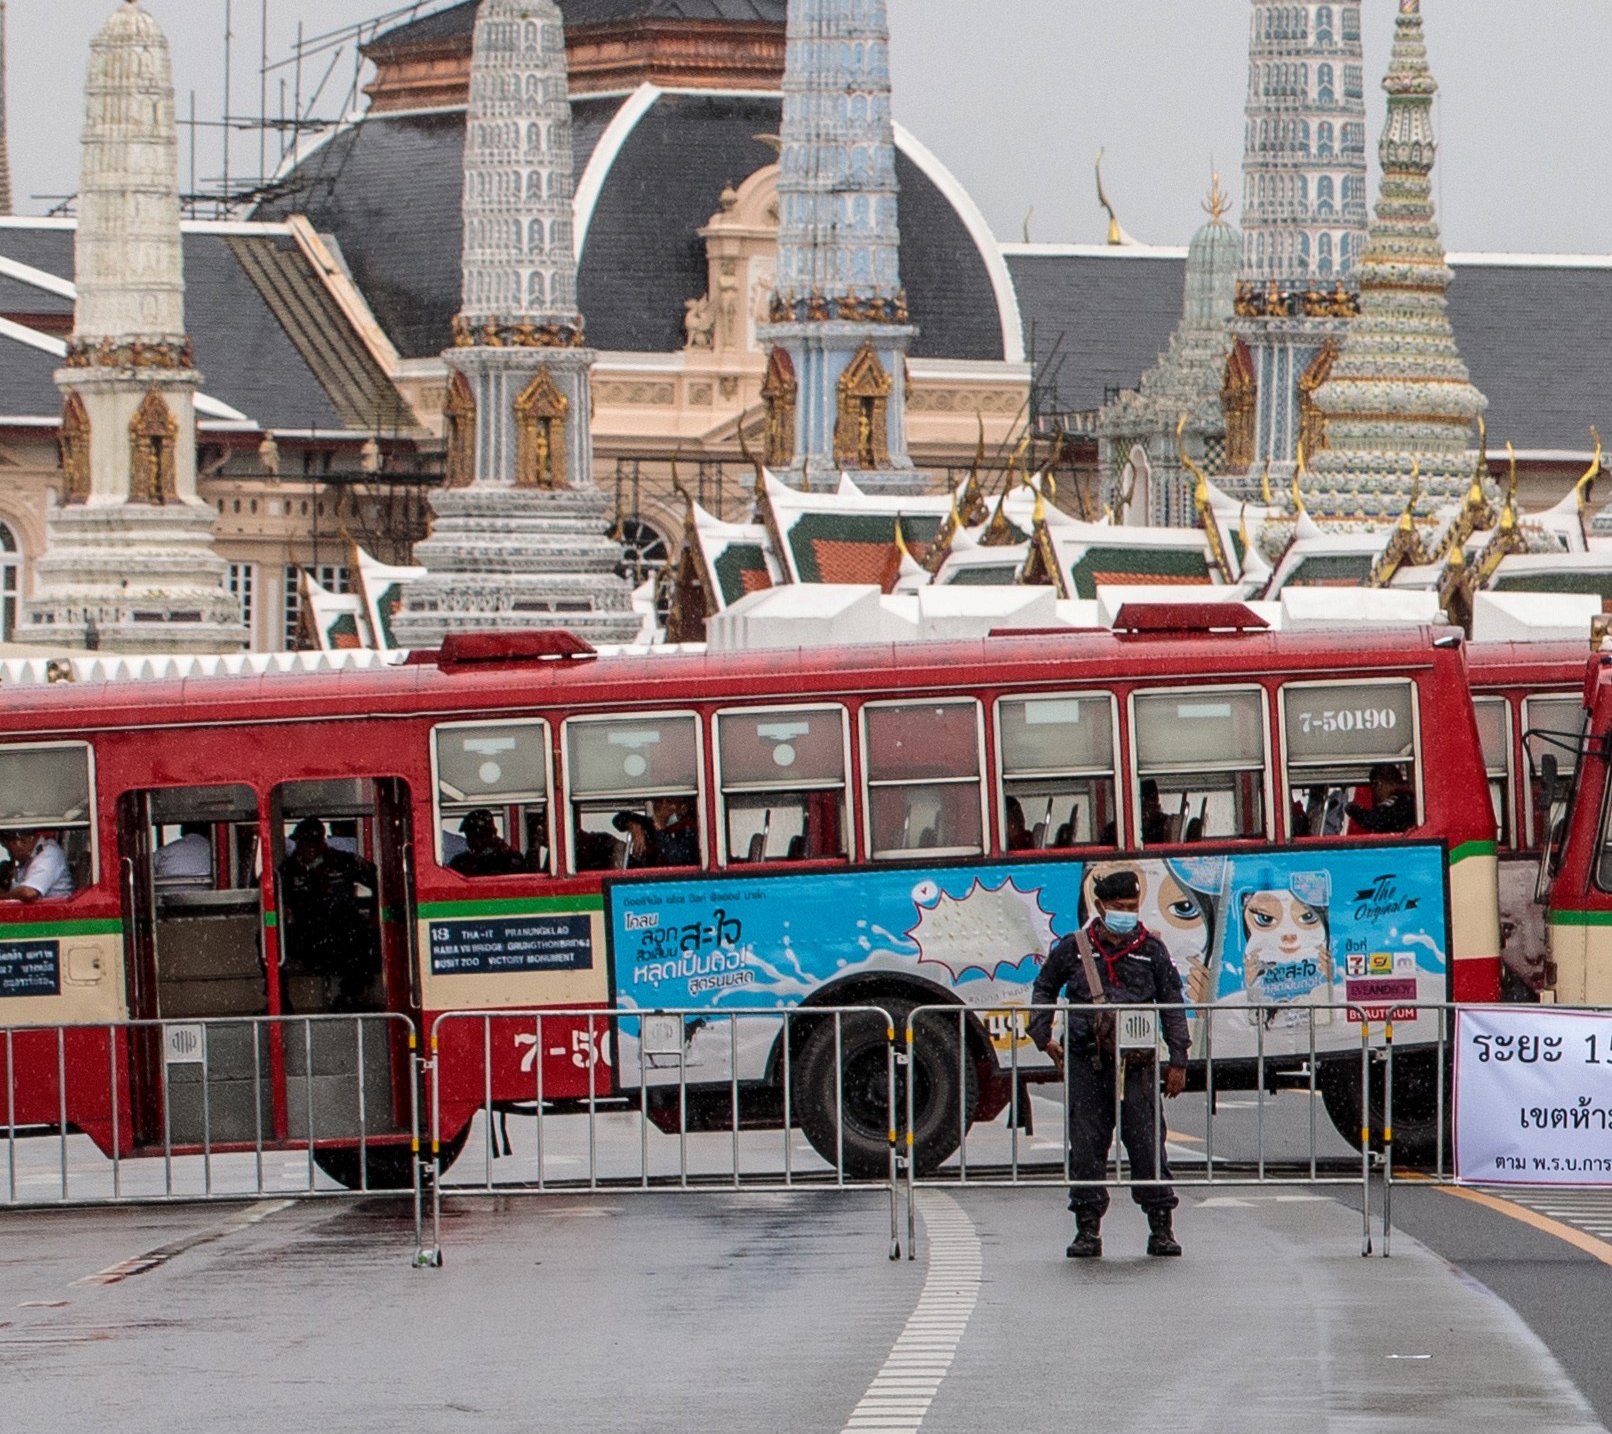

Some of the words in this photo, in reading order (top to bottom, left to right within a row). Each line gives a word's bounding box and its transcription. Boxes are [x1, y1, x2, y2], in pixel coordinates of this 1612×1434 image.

[1299, 708, 1397, 732] 7-50190
[431, 927, 450, 941] 18
[680, 909, 742, 951] สะใจ
[1473, 1033, 1563, 1063] ระยะ
[1495, 1155, 1527, 1171] ตาม
